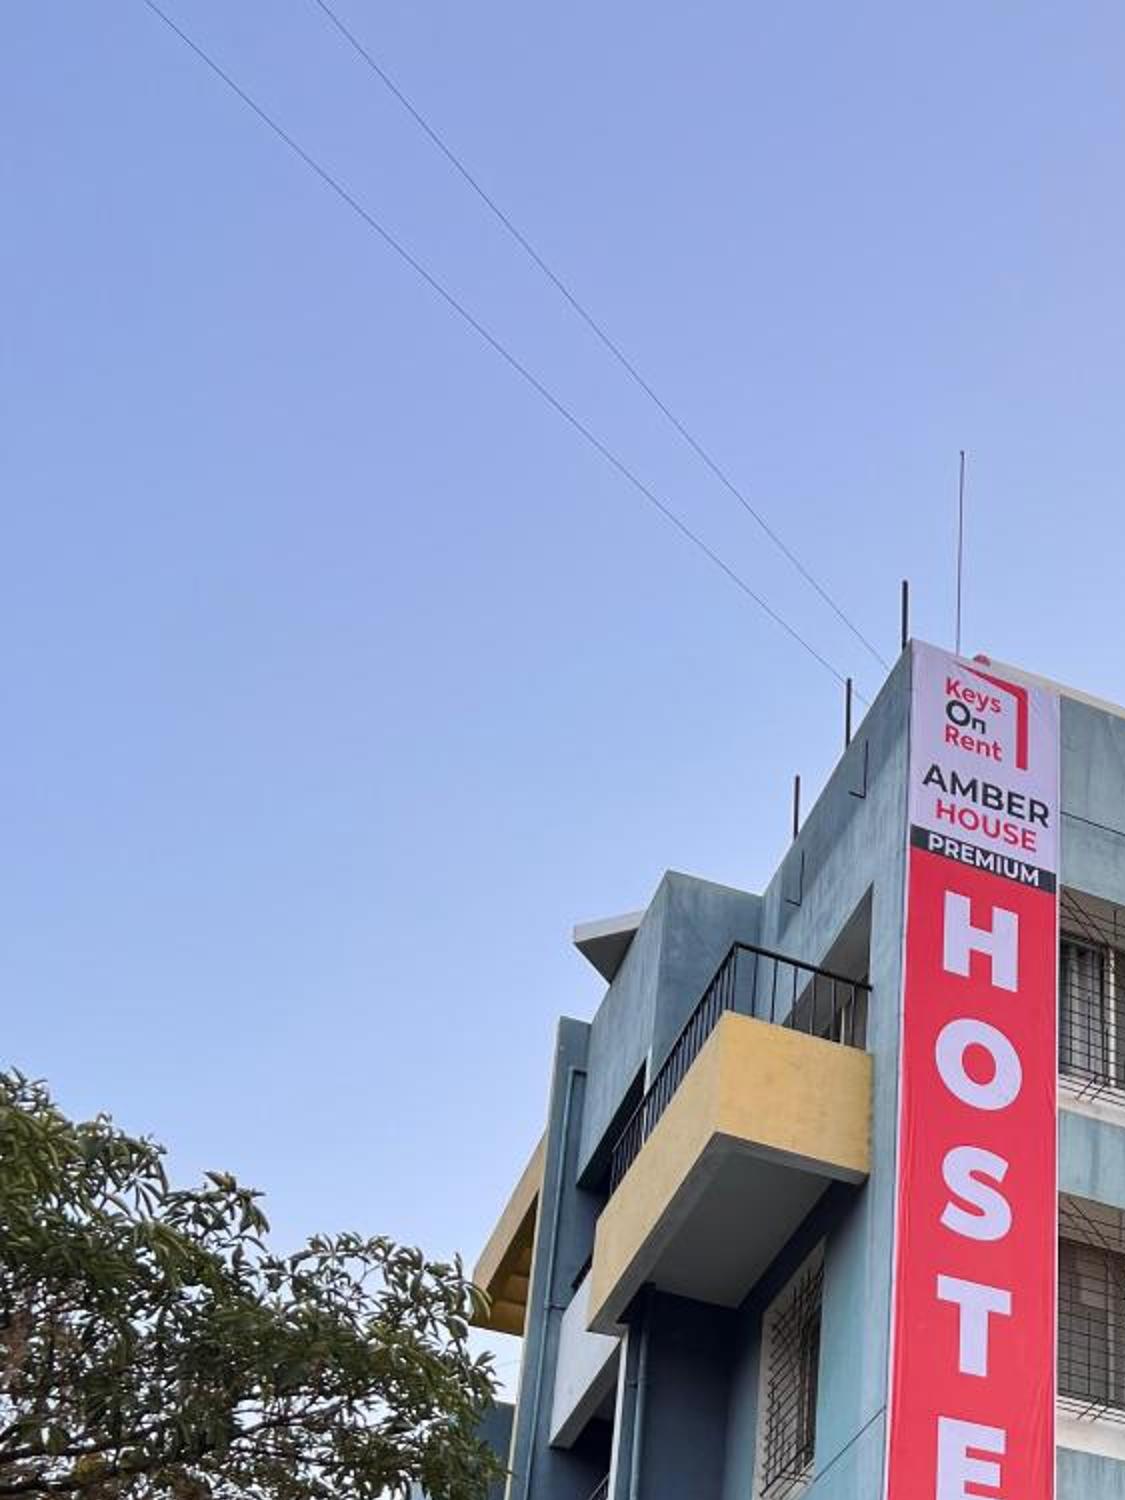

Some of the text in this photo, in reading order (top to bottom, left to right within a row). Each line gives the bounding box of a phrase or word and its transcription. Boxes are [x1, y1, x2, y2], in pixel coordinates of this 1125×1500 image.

[945, 677, 1002, 713] Keys
[945, 699, 986, 734] On
[944, 725, 1003, 761] Rent
[922, 764, 1049, 828] AMBER
[935, 800, 1037, 852] HOUSE
[928, 833, 1039, 886] PREMIUM
